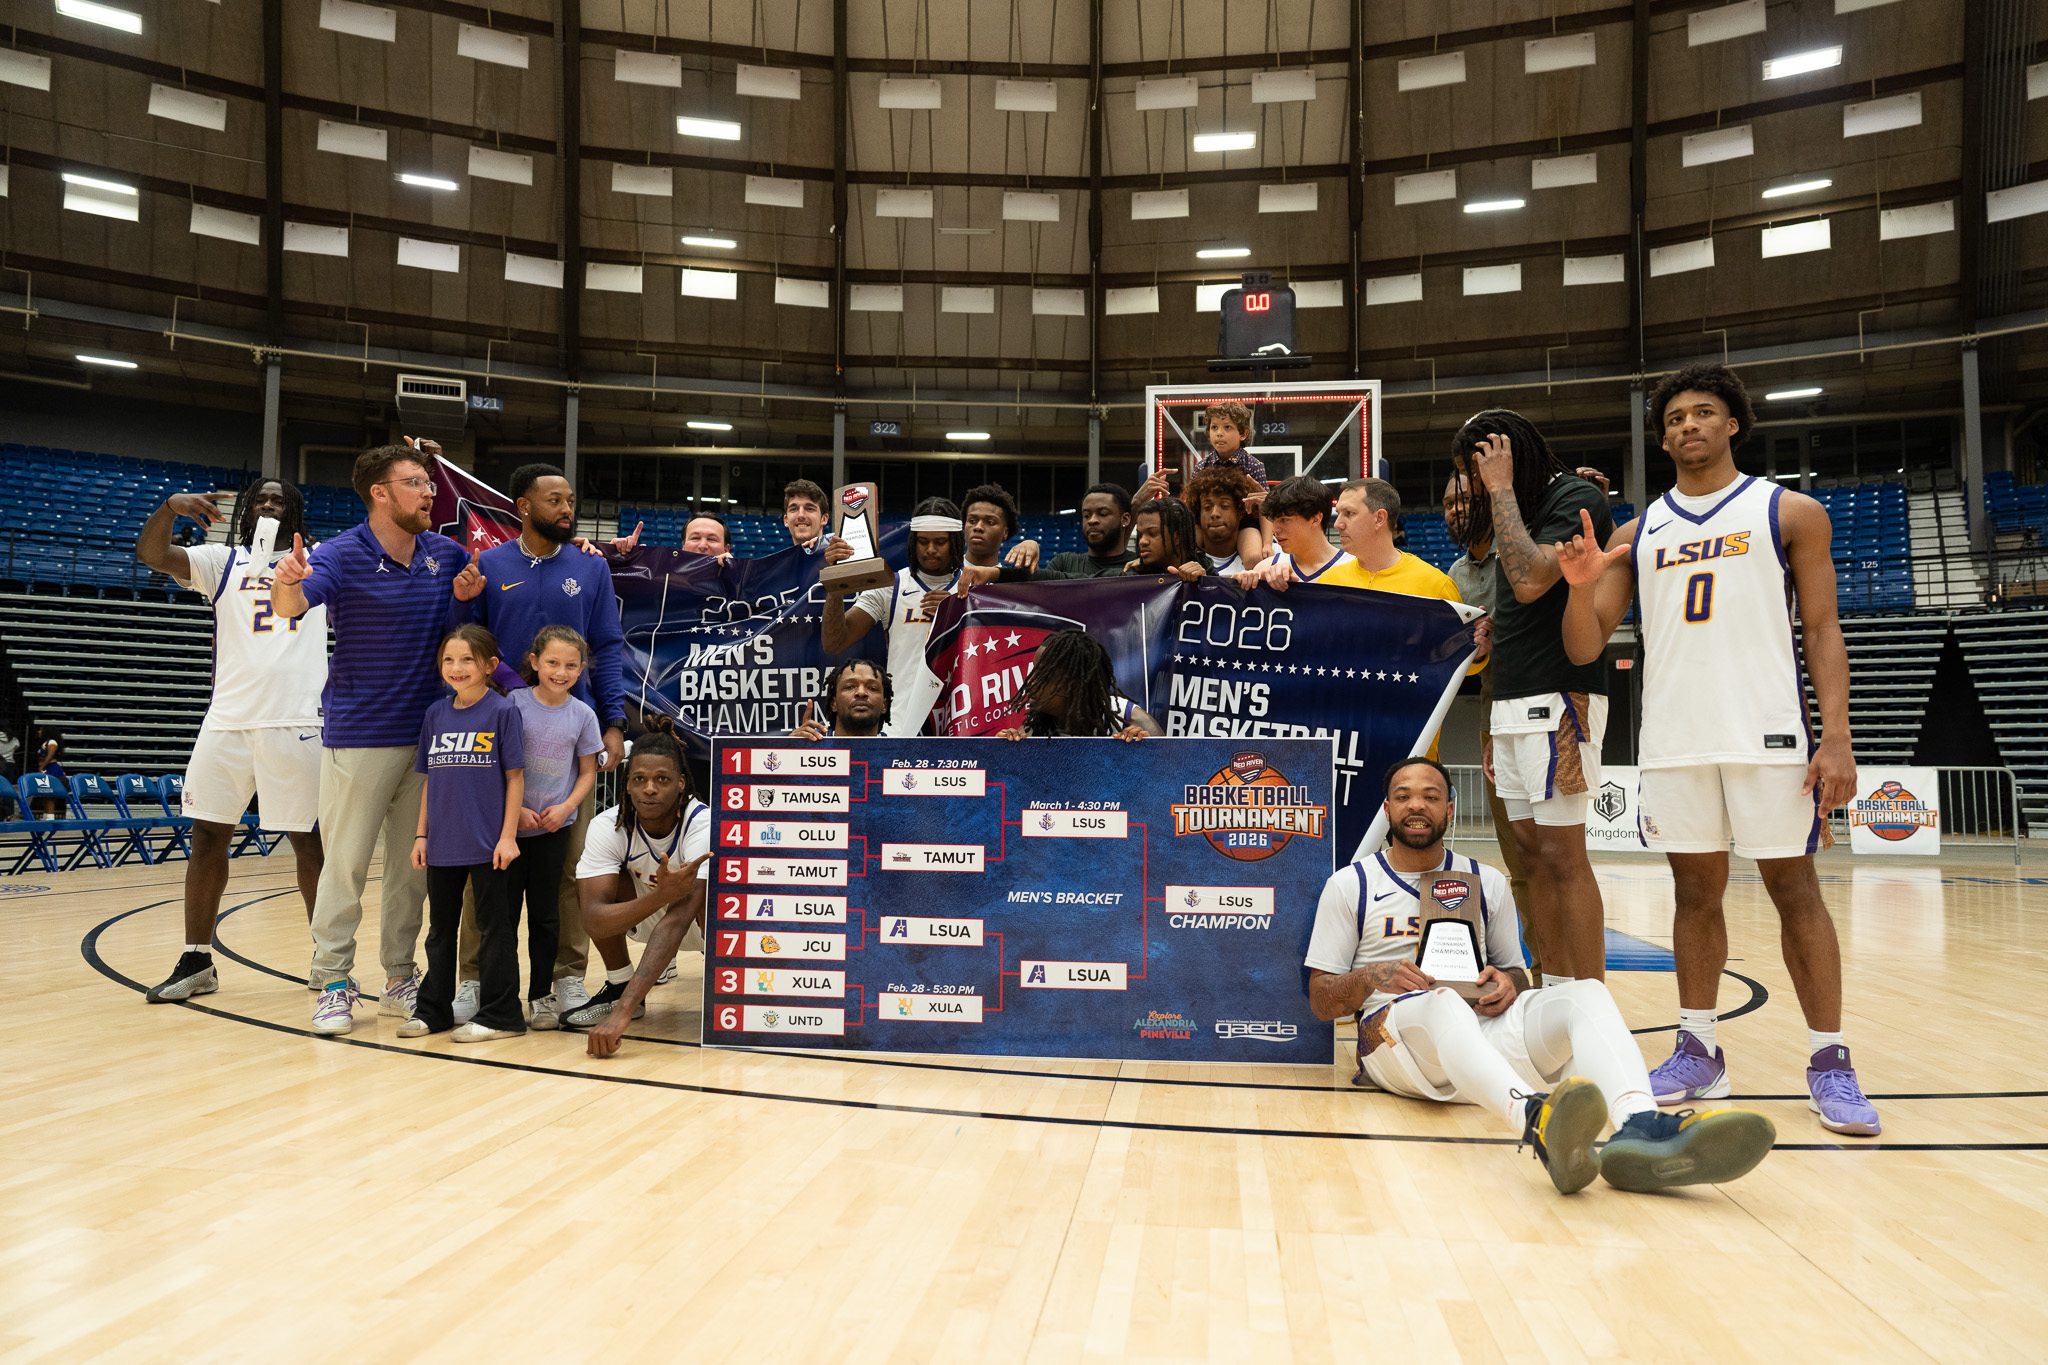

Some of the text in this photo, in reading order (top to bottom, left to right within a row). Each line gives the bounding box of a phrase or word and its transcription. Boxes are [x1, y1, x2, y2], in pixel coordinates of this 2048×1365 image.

[1245, 293, 1270, 311] 0.0
[873, 422, 897, 434] 322
[1263, 423, 1286, 434] 323
[731, 466, 741, 477] G
[1655, 531, 1751, 572] LSUS
[1861, 561, 1878, 569] 125
[1683, 571, 1715, 624] 0
[1178, 600, 1294, 651] 2026
[1169, 673, 1270, 717] MEN’S
[428, 732, 496, 755] LSUS
[730, 752, 742, 773] 1
[800, 756, 837, 768] LSUS
[891, 759, 912, 769] Feb.
[914, 759, 929, 769] 28
[936, 759, 960, 769] 7:30
[961, 759, 978, 769] PM
[1246, 759, 1263, 767] RIVER
[933, 777, 967, 787] LSUS
[727, 788, 744, 809] 8
[781, 792, 841, 805] TAMUSA
[1185, 784, 1313, 807] BASKETBALL
[1029, 801, 1061, 810] March
[1064, 801, 1070, 810] 1
[1078, 801, 1100, 810] 4:30
[1101, 802, 1120, 811] PM
[1857, 800, 1928, 811] BASKETBALL
[1072, 817, 1106, 829] LSUS
[1173, 805, 1324, 835] TOURNAMENT
[1851, 811, 1937, 827] TOURNAMENT
[726, 824, 743, 845] 4
[760, 831, 781, 841] OLLU
[799, 830, 836, 841] OLLU
[1228, 833, 1268, 847] 2026
[1586, 827, 1639, 840] Kingdom
[923, 852, 976, 864] TAMUT
[725, 860, 742, 882] 5
[788, 866, 838, 878] TAMUT
[1448, 886, 1468, 894] RIVER
[1007, 891, 1123, 905] MEN’S BRACKET
[1219, 895, 1253, 908] LSUS
[724, 897, 740, 919] 2
[795, 903, 835, 917] LSUA
[1169, 914, 1271, 930] CHAMPION
[929, 924, 971, 938] LSUA
[724, 934, 740, 955] 7
[802, 940, 831, 953] JCU
[1431, 948, 1469, 956] CHAMPIONS
[721, 970, 738, 991] 3
[1068, 968, 1111, 982] LSUA
[792, 977, 832, 989] XULA
[887, 983, 909, 993] Feb.
[910, 984, 924, 993] 28
[932, 984, 956, 994] 5:30
[957, 985, 975, 995] PM
[928, 1002, 963, 1014] XULA
[720, 1008, 737, 1029] 6
[788, 1015, 823, 1026] UNTD
[1149, 1010, 1182, 1022] Explore
[1133, 1018, 1198, 1031] ALEXANDRIA
[1215, 1021, 1297, 1039] gaeda
[1140, 1029, 1191, 1039] PINEVILLE
